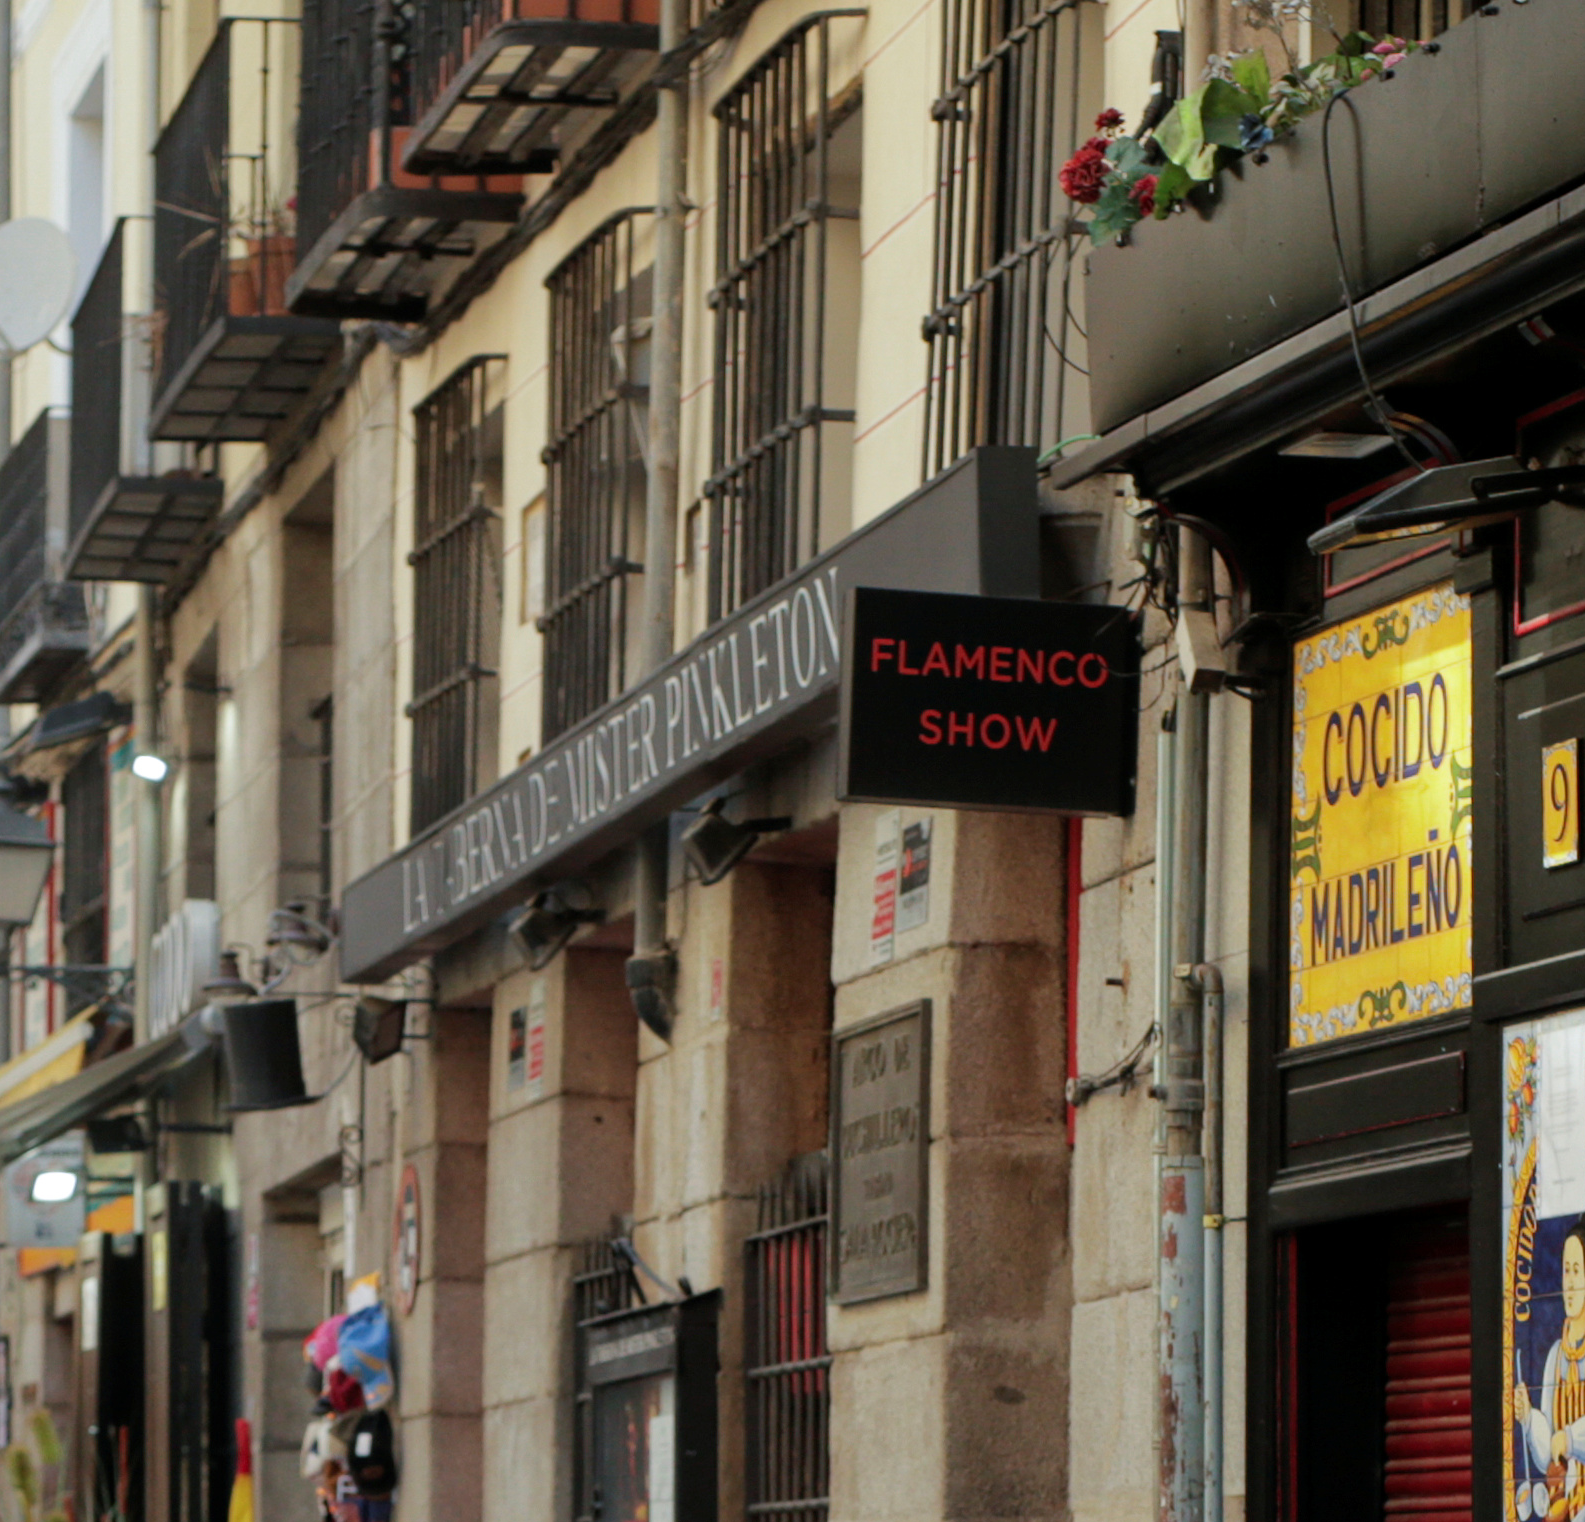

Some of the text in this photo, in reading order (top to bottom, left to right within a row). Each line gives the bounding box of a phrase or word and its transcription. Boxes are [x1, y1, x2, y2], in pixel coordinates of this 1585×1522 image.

[871, 637, 1109, 688] FLAMENCO
[402, 858, 430, 934] LA
[564, 693, 659, 833] MISTER
[665, 566, 840, 768] PINKLETON
[918, 709, 1058, 752] SHOW
[1323, 672, 1448, 806] COCIDO
[1550, 763, 1569, 843] 9
[1311, 828, 1461, 966] MADRILEÑO
[1515, 1205, 1538, 1322] COCIDO
